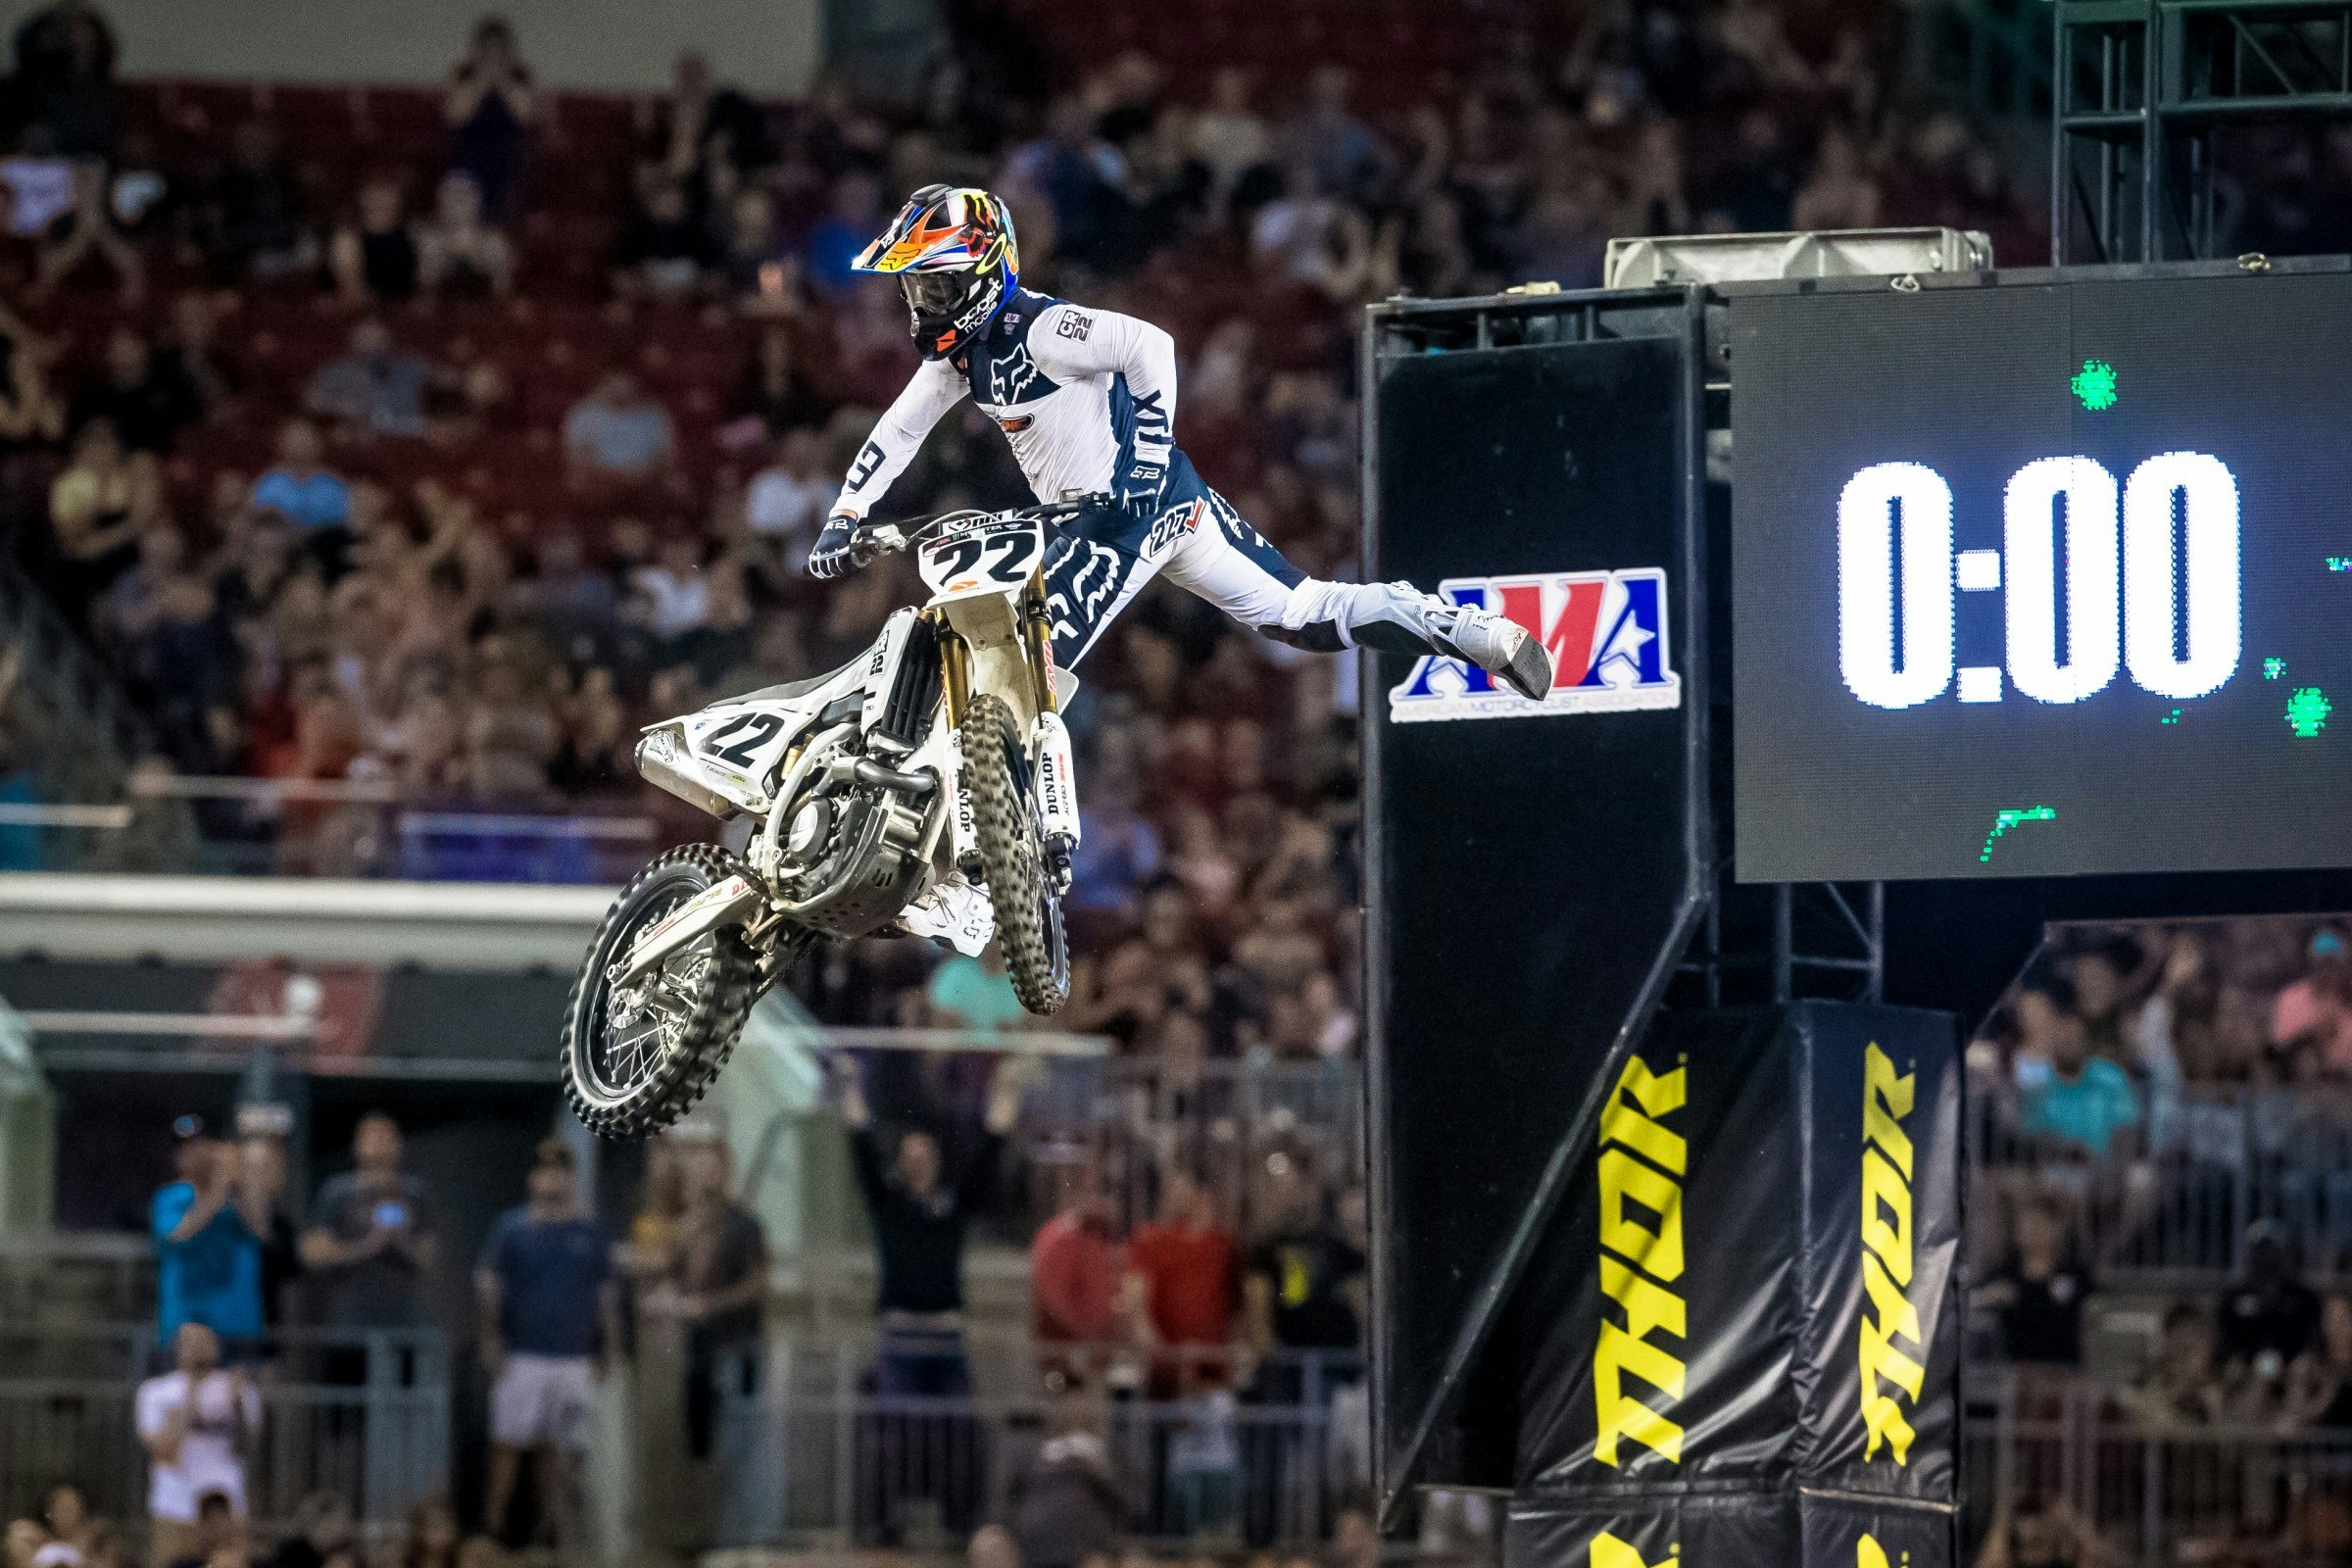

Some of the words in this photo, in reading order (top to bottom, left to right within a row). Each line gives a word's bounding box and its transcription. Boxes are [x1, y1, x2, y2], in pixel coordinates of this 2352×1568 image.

[964, 301, 999, 334] mobile
[1058, 311, 1080, 337] CR
[1073, 317, 1094, 342] 22
[1152, 504, 1193, 556] 227
[934, 532, 1036, 587] 22
[1838, 452, 2242, 710] 0:00
[1400, 575, 1669, 699] AMA
[1395, 702, 1470, 719] AMERICAN
[1581, 690, 1677, 708] ASSOCIATION
[698, 711, 785, 768] 22
[1042, 752, 1058, 815] DUNLOP
[1593, 1054, 1688, 1467] THOR
[1859, 1041, 1924, 1467] THOR
